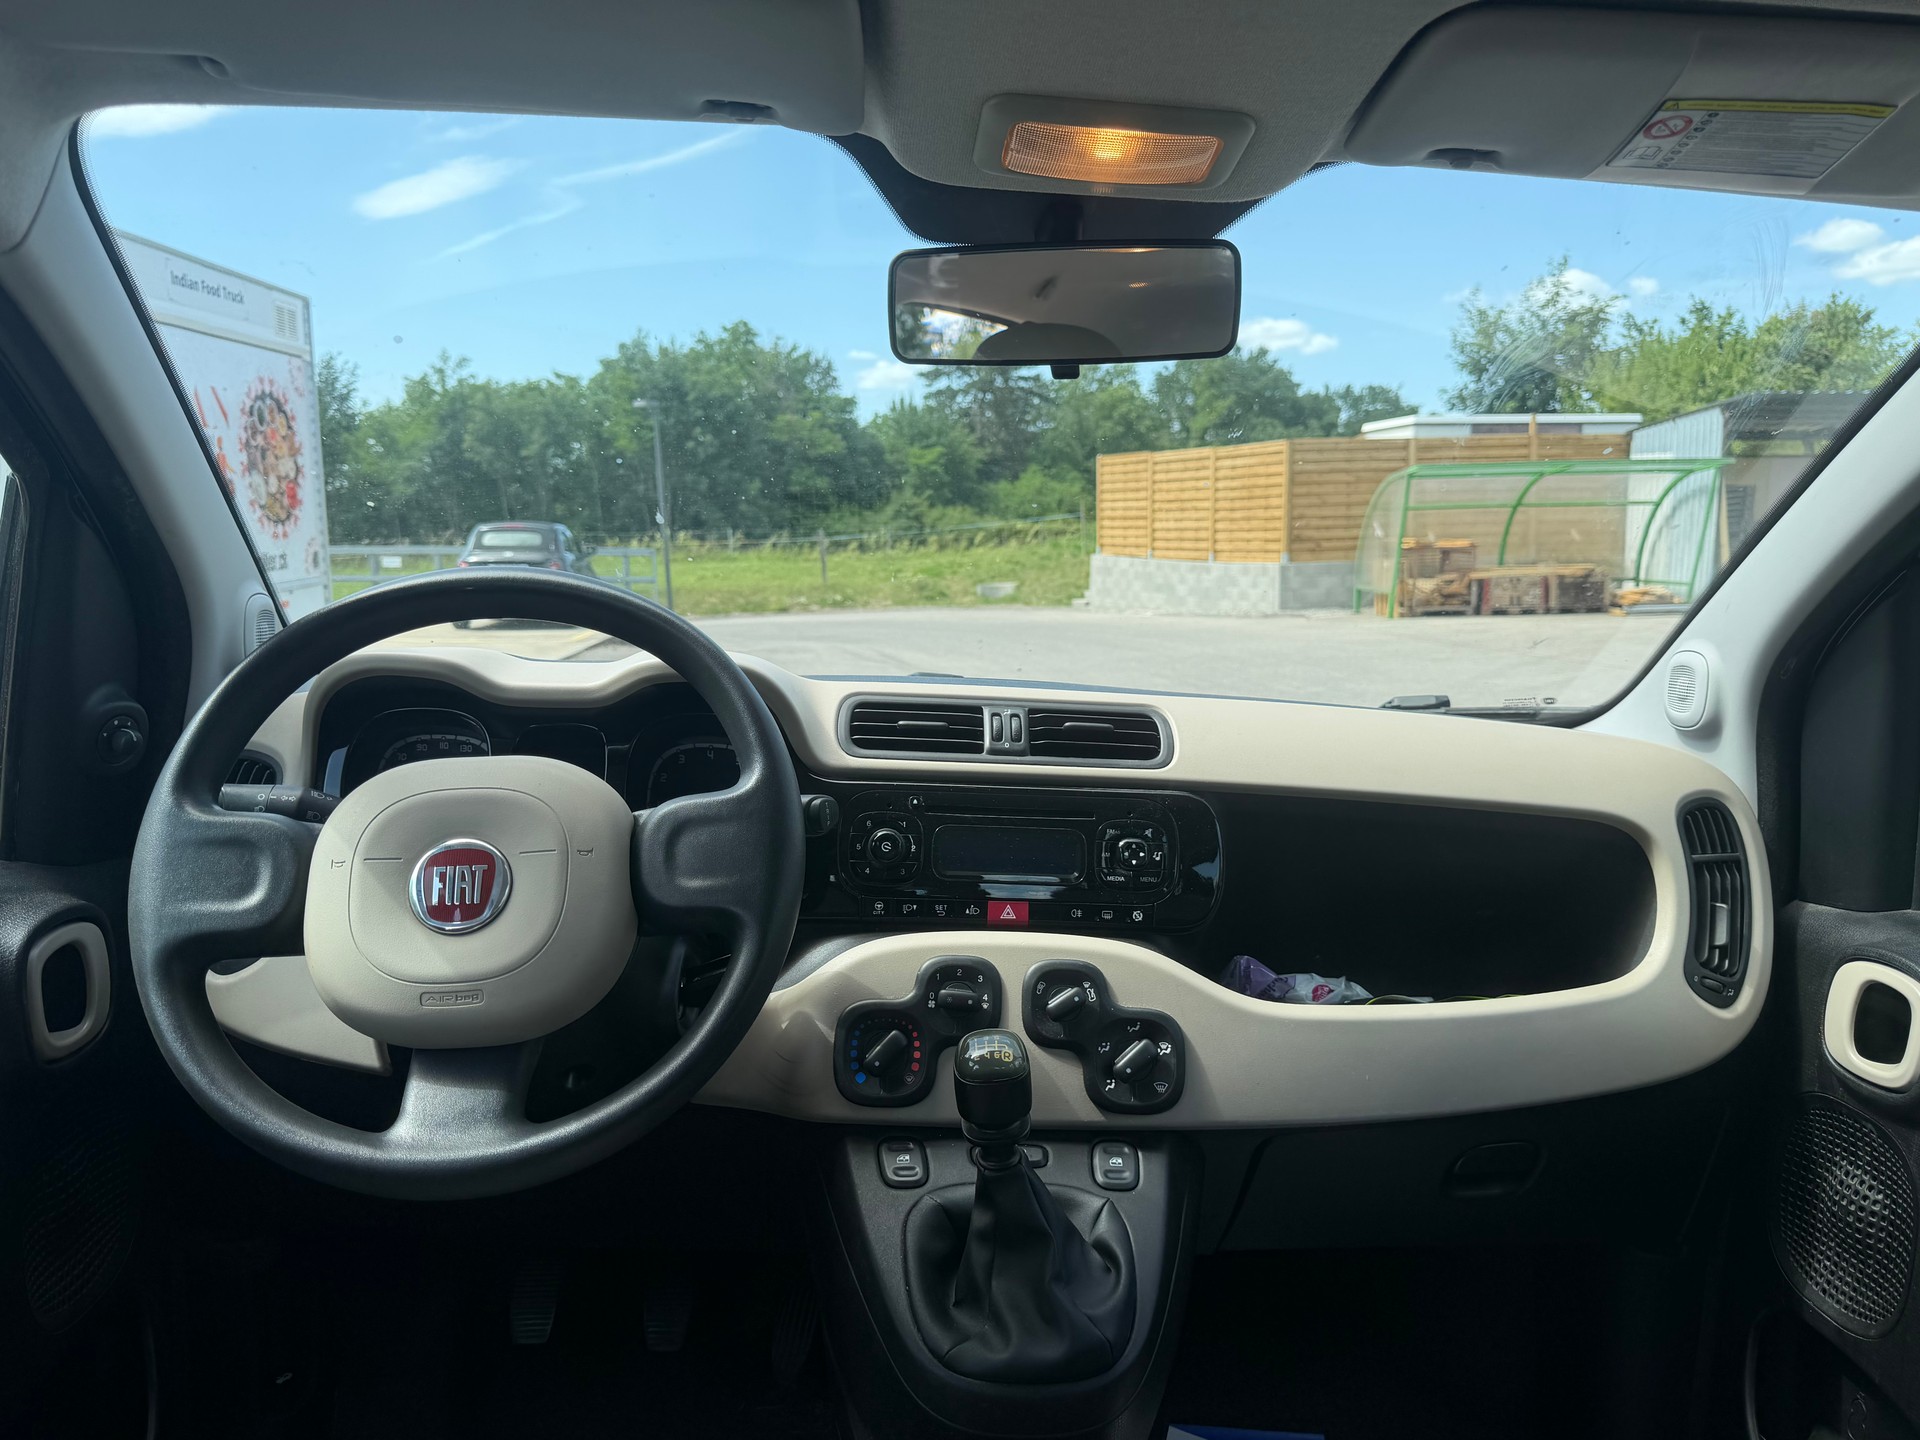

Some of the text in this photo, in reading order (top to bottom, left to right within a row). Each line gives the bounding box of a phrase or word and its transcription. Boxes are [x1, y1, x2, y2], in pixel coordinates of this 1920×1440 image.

[170, 269, 245, 304] Indian Food Truck
[415, 743, 428, 752] 90
[439, 741, 449, 750] 110
[459, 744, 473, 753] 130
[678, 754, 686, 764] 3
[706, 750, 714, 760] 4
[660, 772, 668, 783] 2
[866, 819, 872, 827] 6
[855, 843, 862, 851] 5
[910, 844, 916, 852] 2
[431, 864, 488, 906] FIAT
[956, 968, 963, 976] 2
[977, 974, 984, 983] 3
[982, 993, 989, 1001] 4
[994, 1051, 1000, 1059] 6
[1003, 1051, 1011, 1060] R
